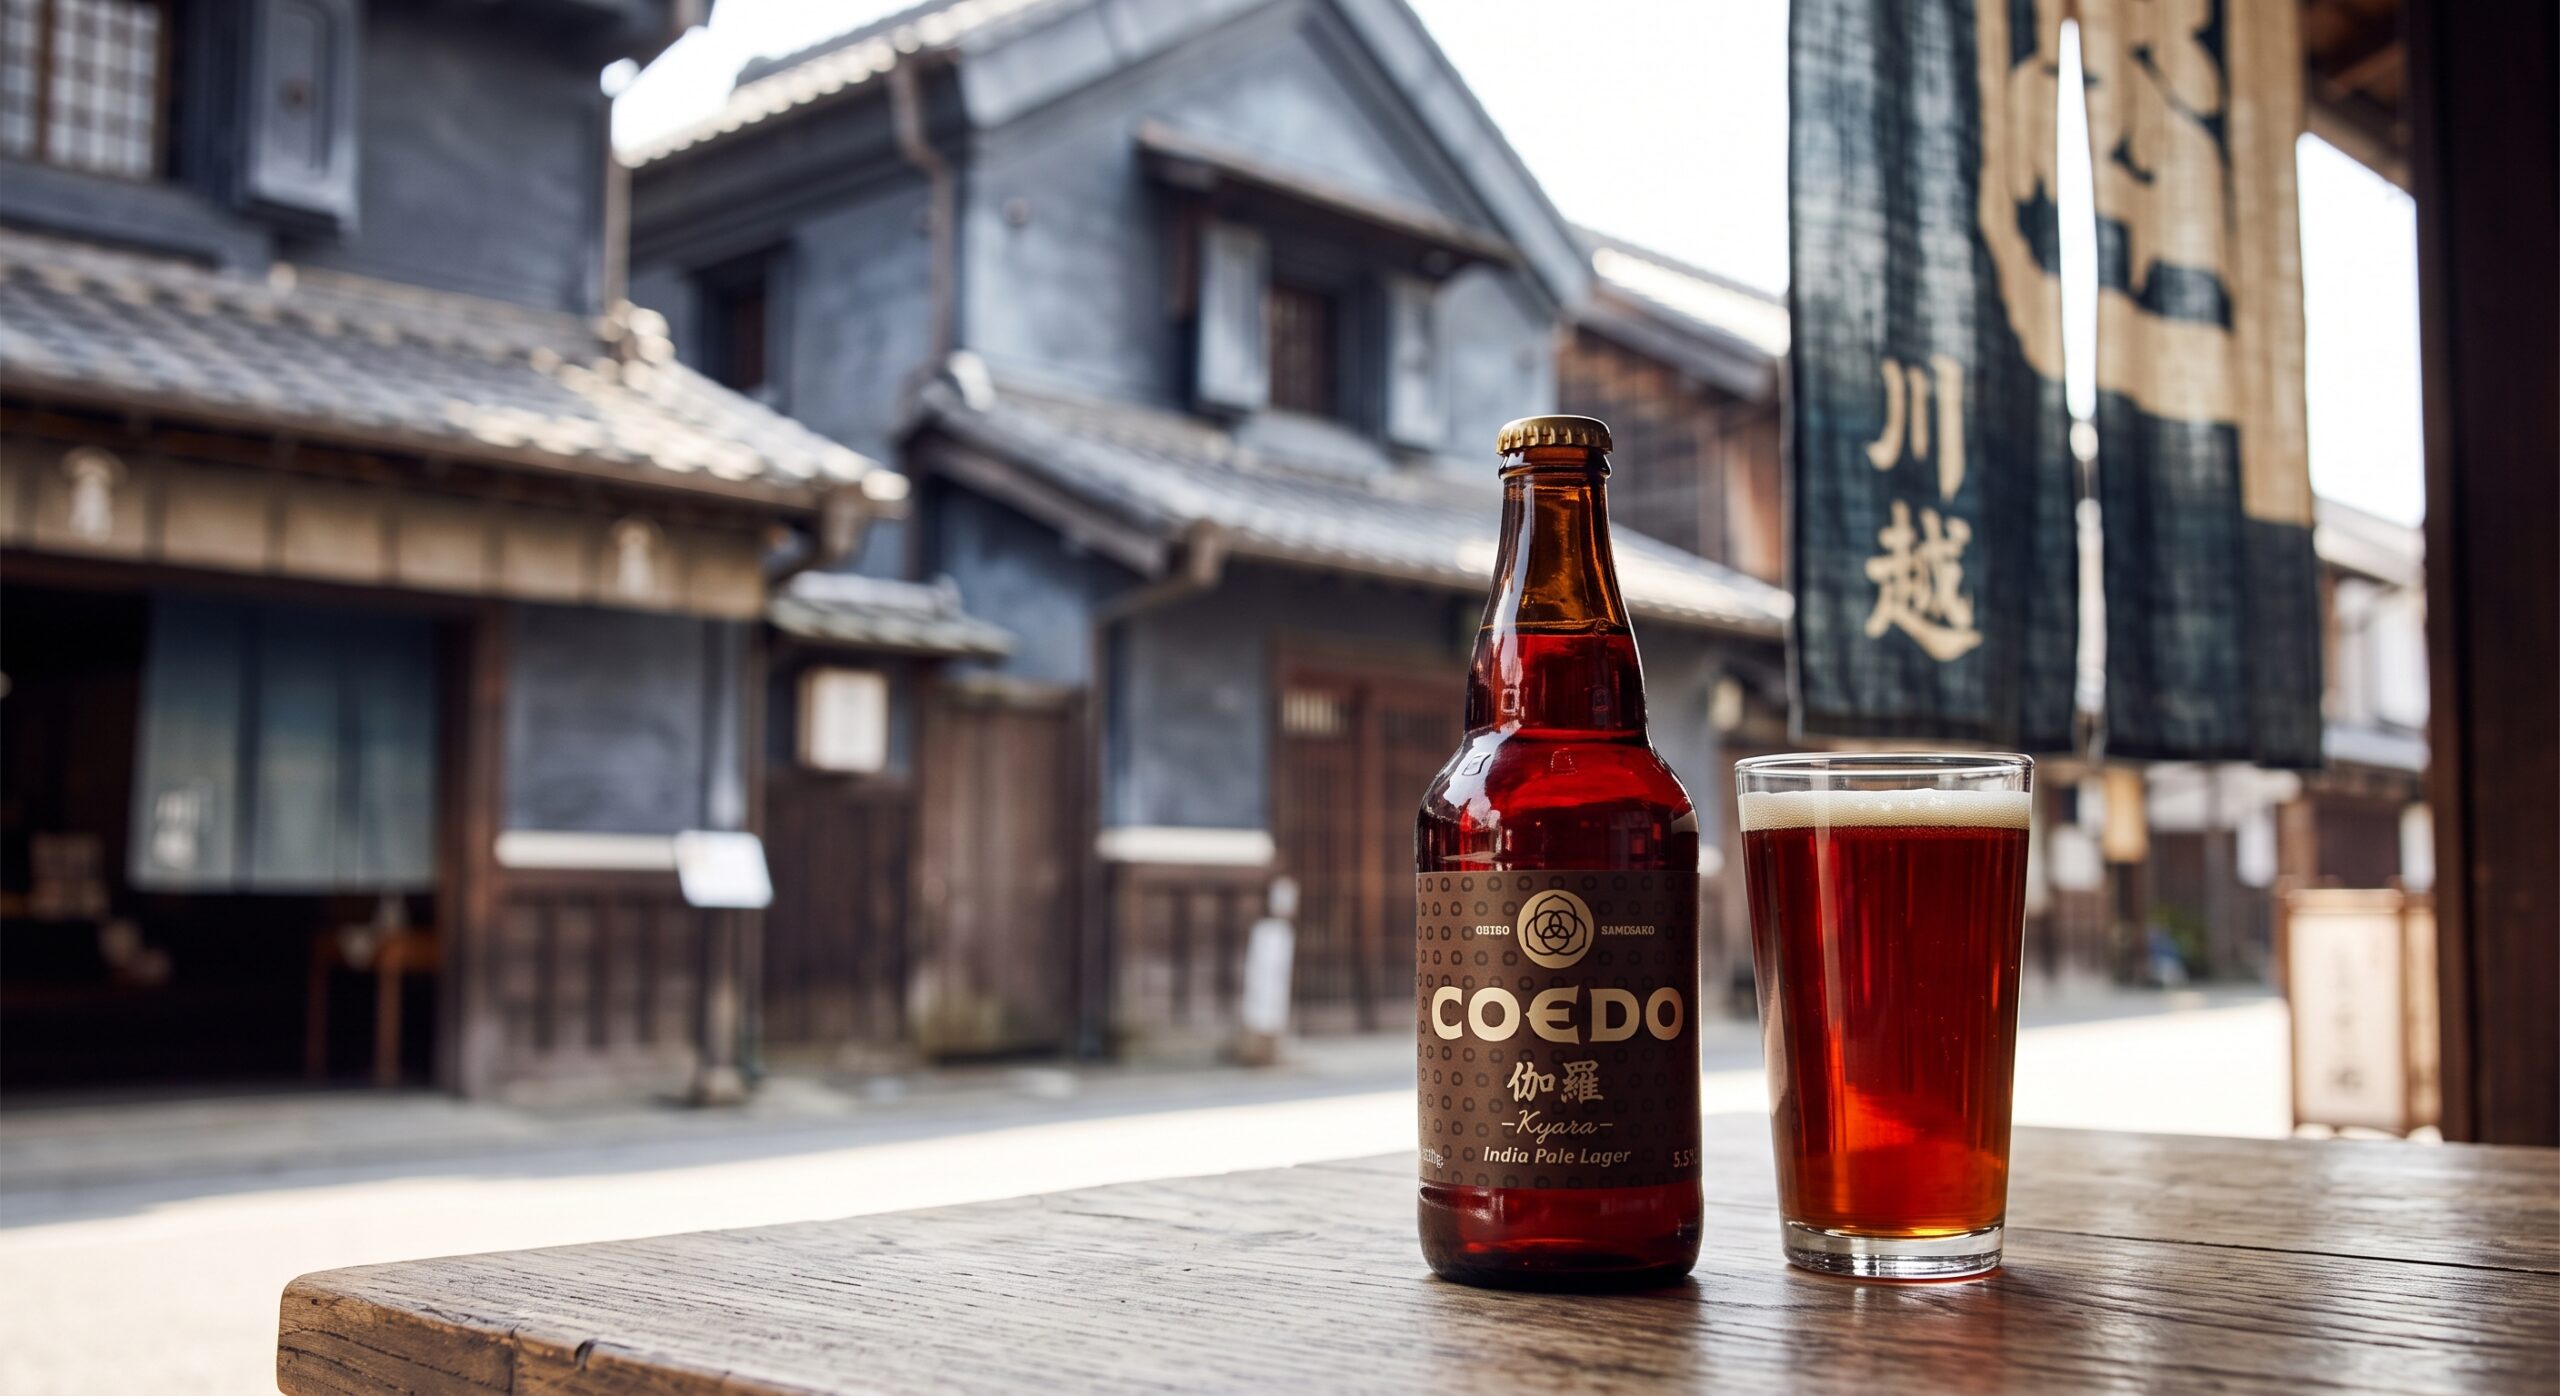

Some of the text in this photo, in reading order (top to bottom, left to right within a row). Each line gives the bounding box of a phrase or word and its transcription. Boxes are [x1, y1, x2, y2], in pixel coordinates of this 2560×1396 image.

[1867, 354, 1982, 661] 川越
[1431, 985, 1684, 1044] COEDO
[1507, 1060, 1604, 1104] 伽羅
[1483, 1146, 1631, 1167] India Pale Lager
